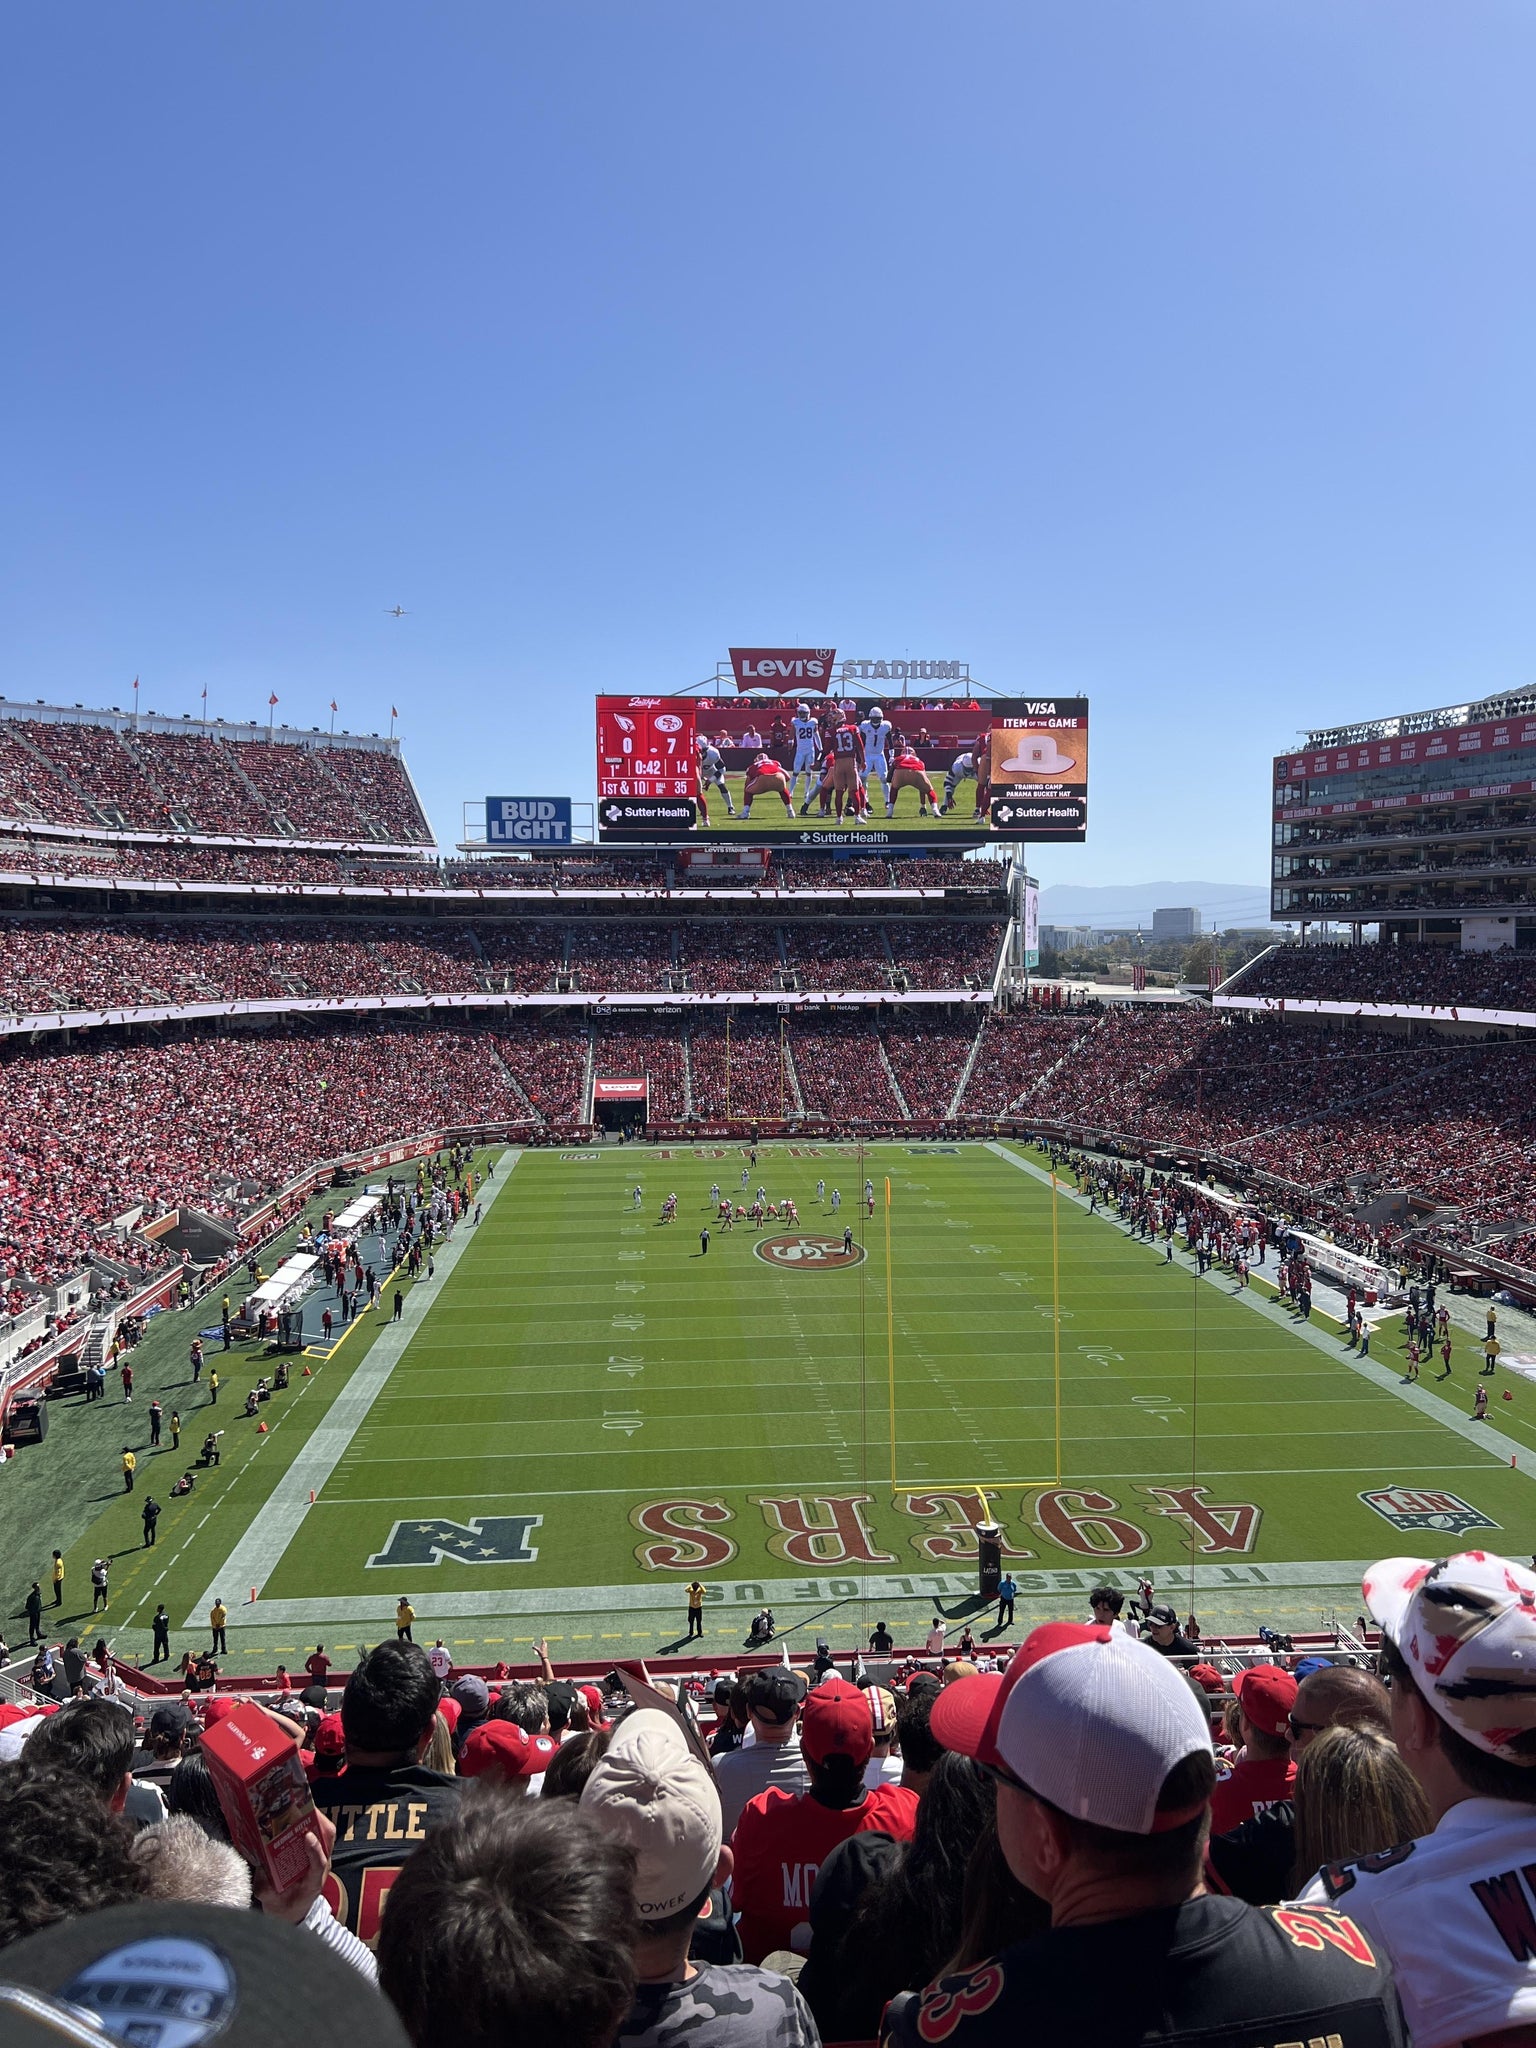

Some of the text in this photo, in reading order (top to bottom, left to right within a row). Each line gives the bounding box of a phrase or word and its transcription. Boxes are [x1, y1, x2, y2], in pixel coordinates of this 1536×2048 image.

[843, 659, 960, 680] STADIUM
[1024, 702, 1056, 715] VISA
[1003, 719, 1027, 728] ITEM
[1048, 719, 1077, 728] GAME
[799, 727, 812, 739] 28
[622, 737, 632, 754] 0
[667, 738, 677, 754] 7
[835, 732, 854, 751] 13
[635, 760, 661, 775] 0:42
[676, 760, 688, 774] 14
[602, 781, 645, 795] 1ST & 10
[674, 781, 687, 795] 35
[501, 801, 556, 820] BUD
[624, 807, 690, 817] Sutter Health
[1015, 807, 1079, 818] Sutter Health
[491, 820, 567, 840] LIGHT
[812, 832, 888, 843] Sutter Health
[652, 1006, 682, 1014] verizon
[836, 1004, 859, 1012] NetApp
[611, 1313, 645, 1327] 30
[1077, 1345, 1125, 1361] 20
[607, 1355, 644, 1372] 20
[1131, 1395, 1186, 1414] 10
[601, 1409, 644, 1429] 10
[1369, 1491, 1466, 1513] NFL
[628, 1484, 1265, 1572] 49ERS
[702, 1566, 1270, 1602] IT TAKES ALL OF US
[431, 1656, 443, 1667] 23
[323, 1803, 428, 1842] ITTLE
[637, 1891, 686, 1914] OWER
